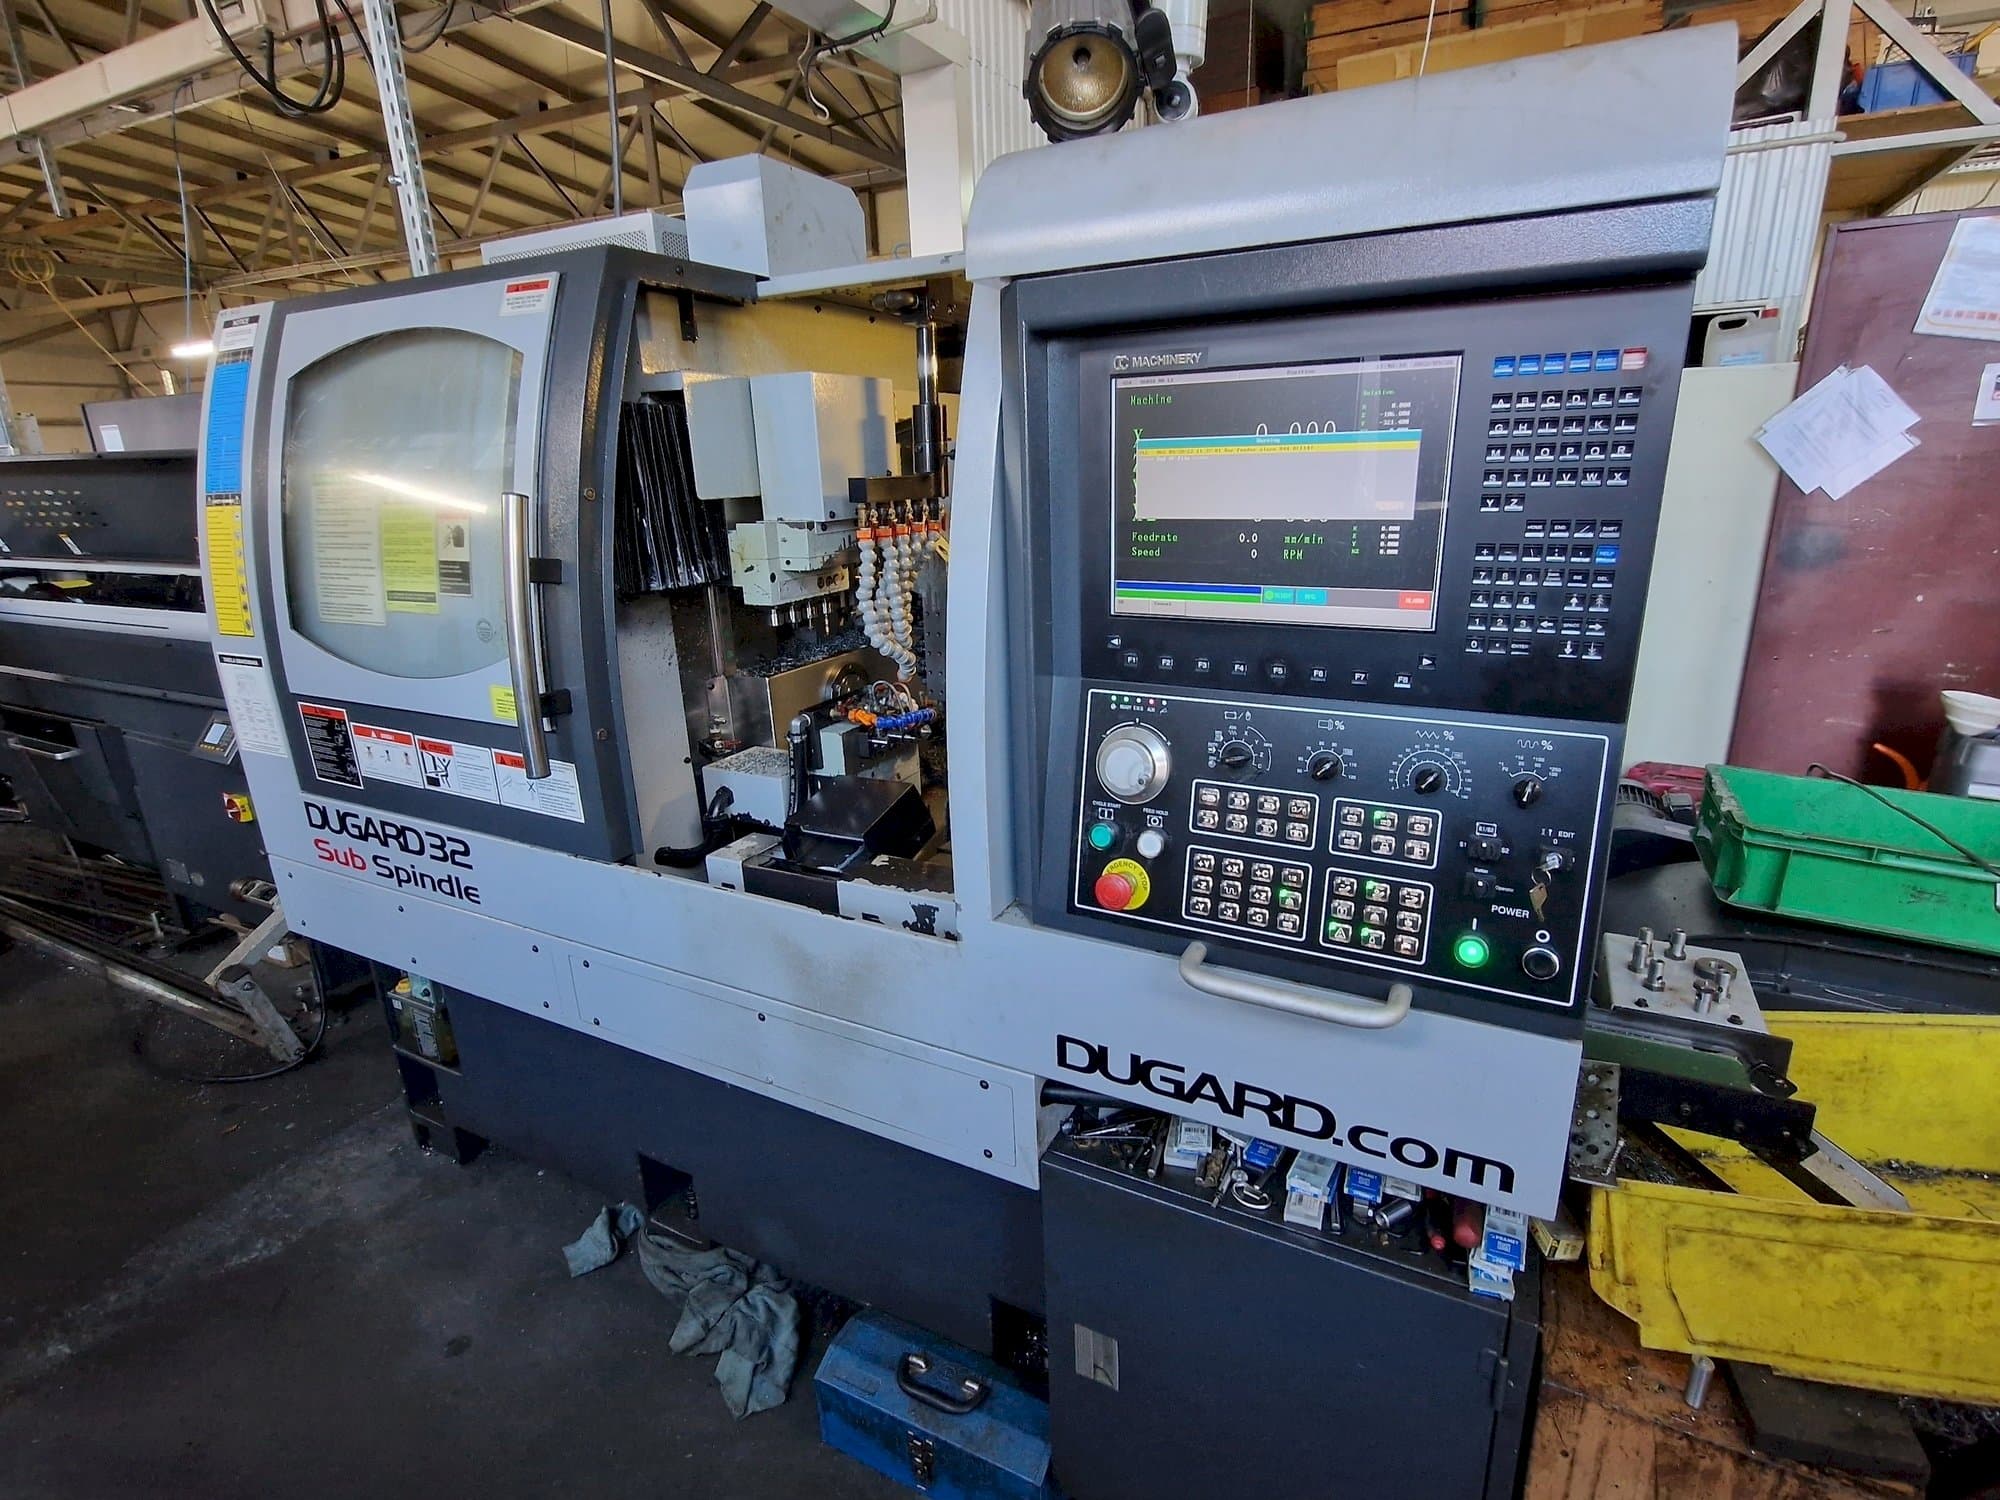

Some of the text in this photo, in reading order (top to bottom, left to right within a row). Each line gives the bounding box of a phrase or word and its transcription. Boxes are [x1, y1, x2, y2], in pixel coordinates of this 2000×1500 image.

[1132, 352, 1202, 368] MACHINERY
[1130, 394, 1172, 406] Machine
[1132, 532, 1324, 545] Feedrate 0.0 mm/min
[1131, 547, 1303, 560] Speed 0 RPM
[1162, 659, 1171, 667] F2
[1198, 661, 1208, 669] F3
[1234, 664, 1245, 672] F4
[1273, 667, 1284, 675] F5
[1313, 670, 1324, 678] F6
[1354, 673, 1365, 681] F7
[1397, 676, 1409, 684] F8
[1558, 830, 1575, 838] EDIT
[313, 838, 481, 905] Sub Spindle
[1491, 904, 1530, 919] POWER
[1056, 1034, 1516, 1194] DUGARD.com
